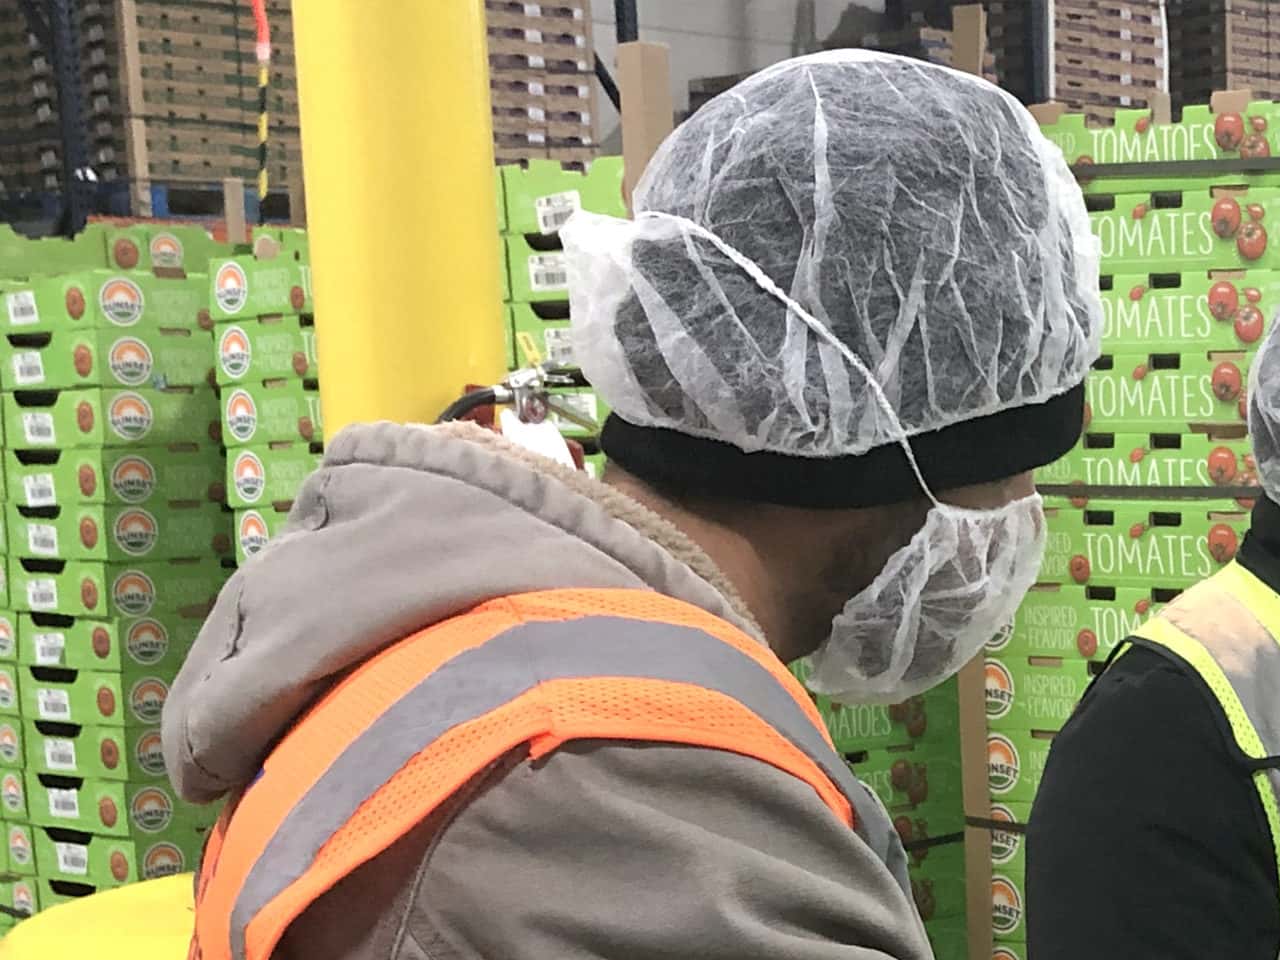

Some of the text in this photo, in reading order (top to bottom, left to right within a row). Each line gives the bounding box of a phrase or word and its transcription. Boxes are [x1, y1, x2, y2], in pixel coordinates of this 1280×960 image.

[1089, 123, 1218, 163] TOMATOES
[1100, 295, 1212, 339] OMATES
[1087, 375, 1214, 417] TOMATES
[1082, 456, 1209, 487] TOMATES
[1082, 532, 1211, 577] TOMATES
[985, 688, 1012, 702] NSET
[988, 764, 1018, 777] NSET
[991, 831, 1017, 848] NSET
[993, 904, 1021, 920] NSET
